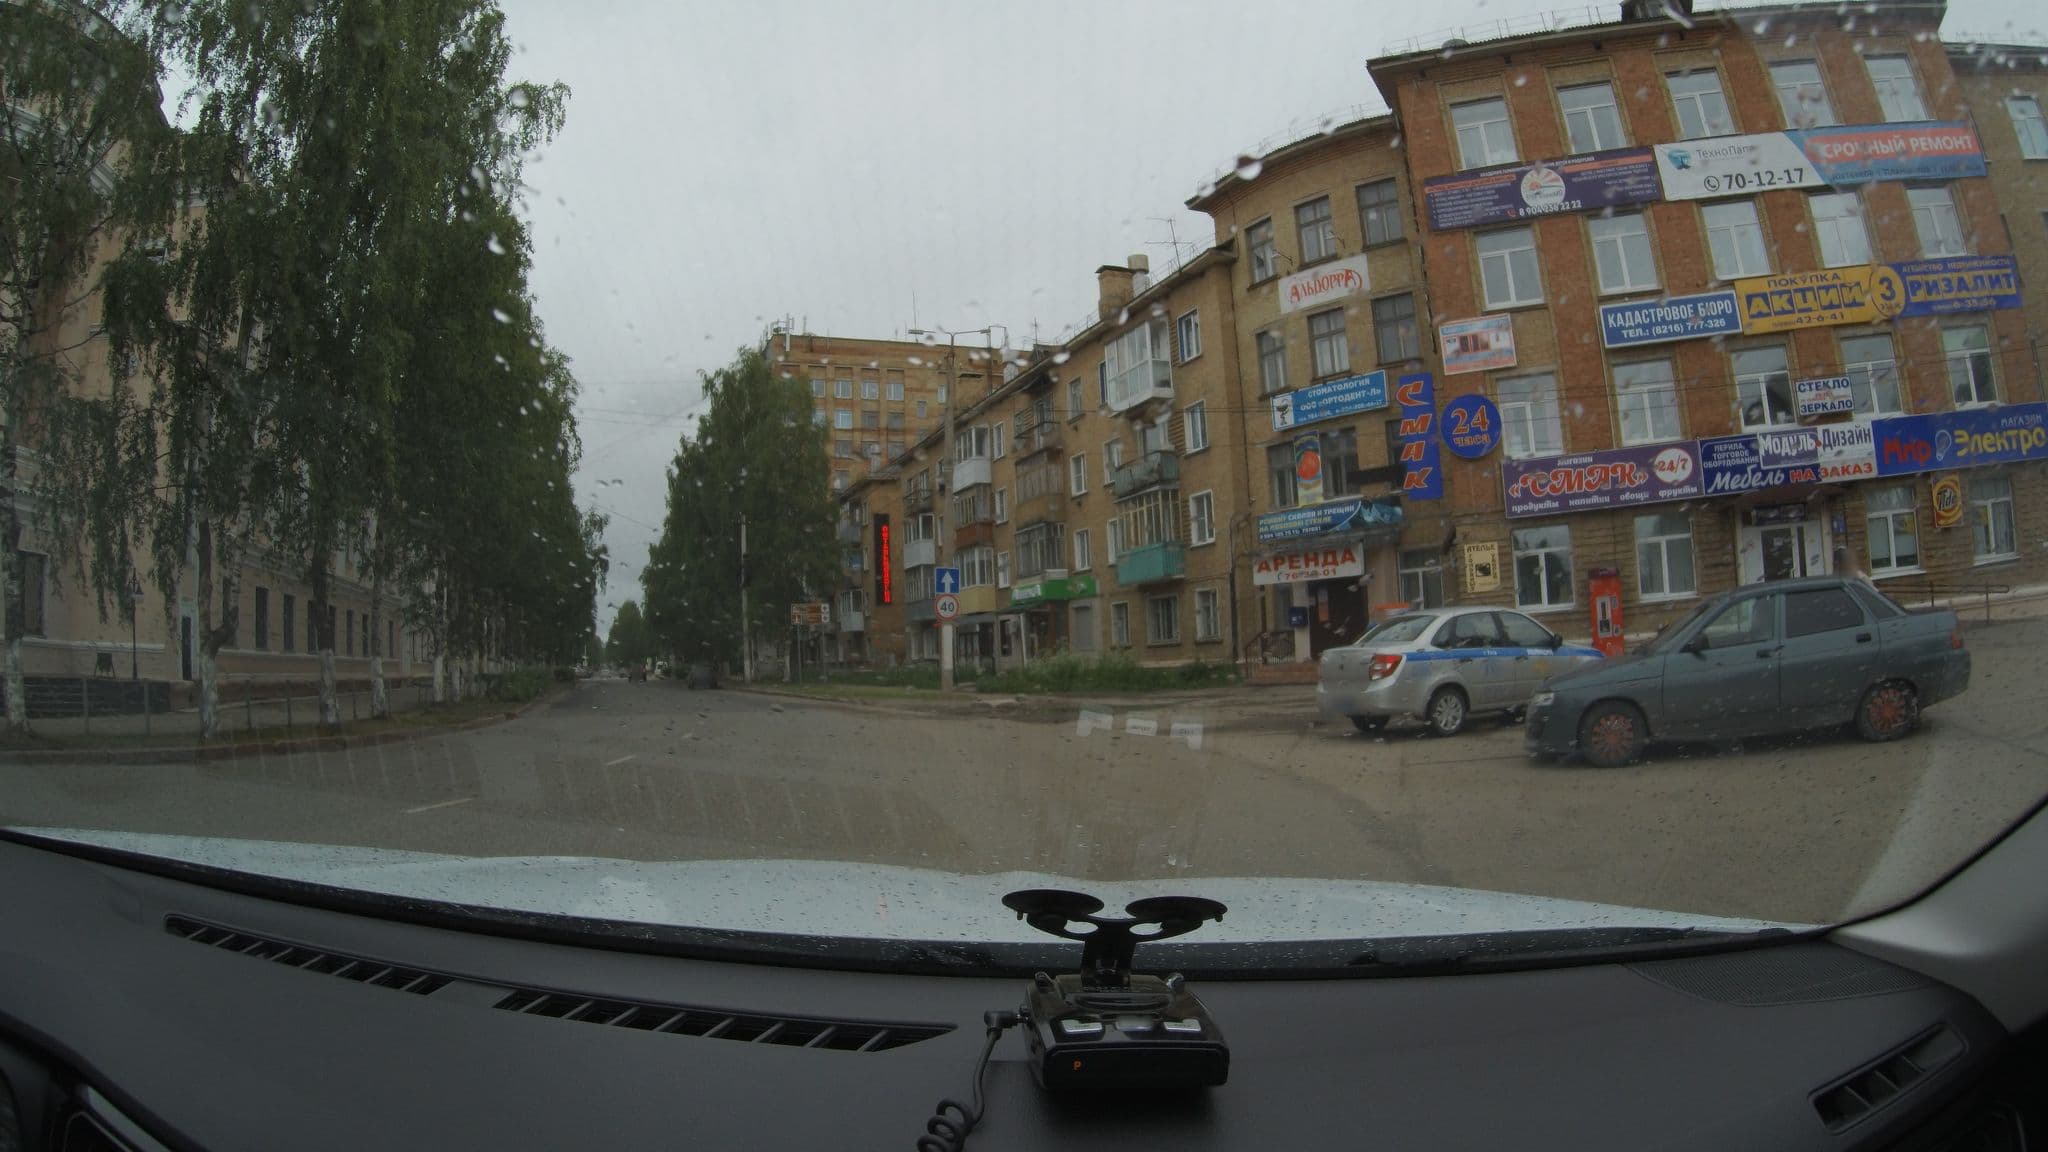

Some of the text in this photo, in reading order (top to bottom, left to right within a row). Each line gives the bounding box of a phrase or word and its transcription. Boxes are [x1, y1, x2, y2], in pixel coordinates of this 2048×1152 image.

[1910, 135, 1974, 153] РЕМОНТ
[1723, 168, 1804, 190] 70-12-17
[1571, 198, 1583, 210] 22
[1767, 273, 1841, 288] ПОКУПКА
[1878, 276, 1896, 301] 3
[1908, 272, 2015, 299] РИЗАЛИТ
[1607, 299, 1733, 328] КАДАСТРОВОЕ БЮРО
[1652, 323, 1684, 337] (8216)
[1308, 378, 1371, 398] СТОМАТОЛОГИЯ
[1797, 377, 1850, 393] СТЕКЛО
[1800, 399, 1853, 414] ЗЕРКАЛО
[1450, 404, 1489, 435] 24
[2001, 414, 2043, 427] МАГАЗИН
[1396, 380, 1432, 490] СМАК
[1712, 450, 1750, 459] ТОРГОВОЕ
[1883, 426, 2046, 467] Мир Электро
[1657, 454, 1688, 474] 24/7
[1707, 462, 1873, 493] Мебель НА ЗАКАЗ
[1511, 501, 1559, 513] продукты
[1569, 494, 1610, 508] напитки
[1257, 549, 1357, 574] АРЕНДА
[940, 600, 954, 612] 40
